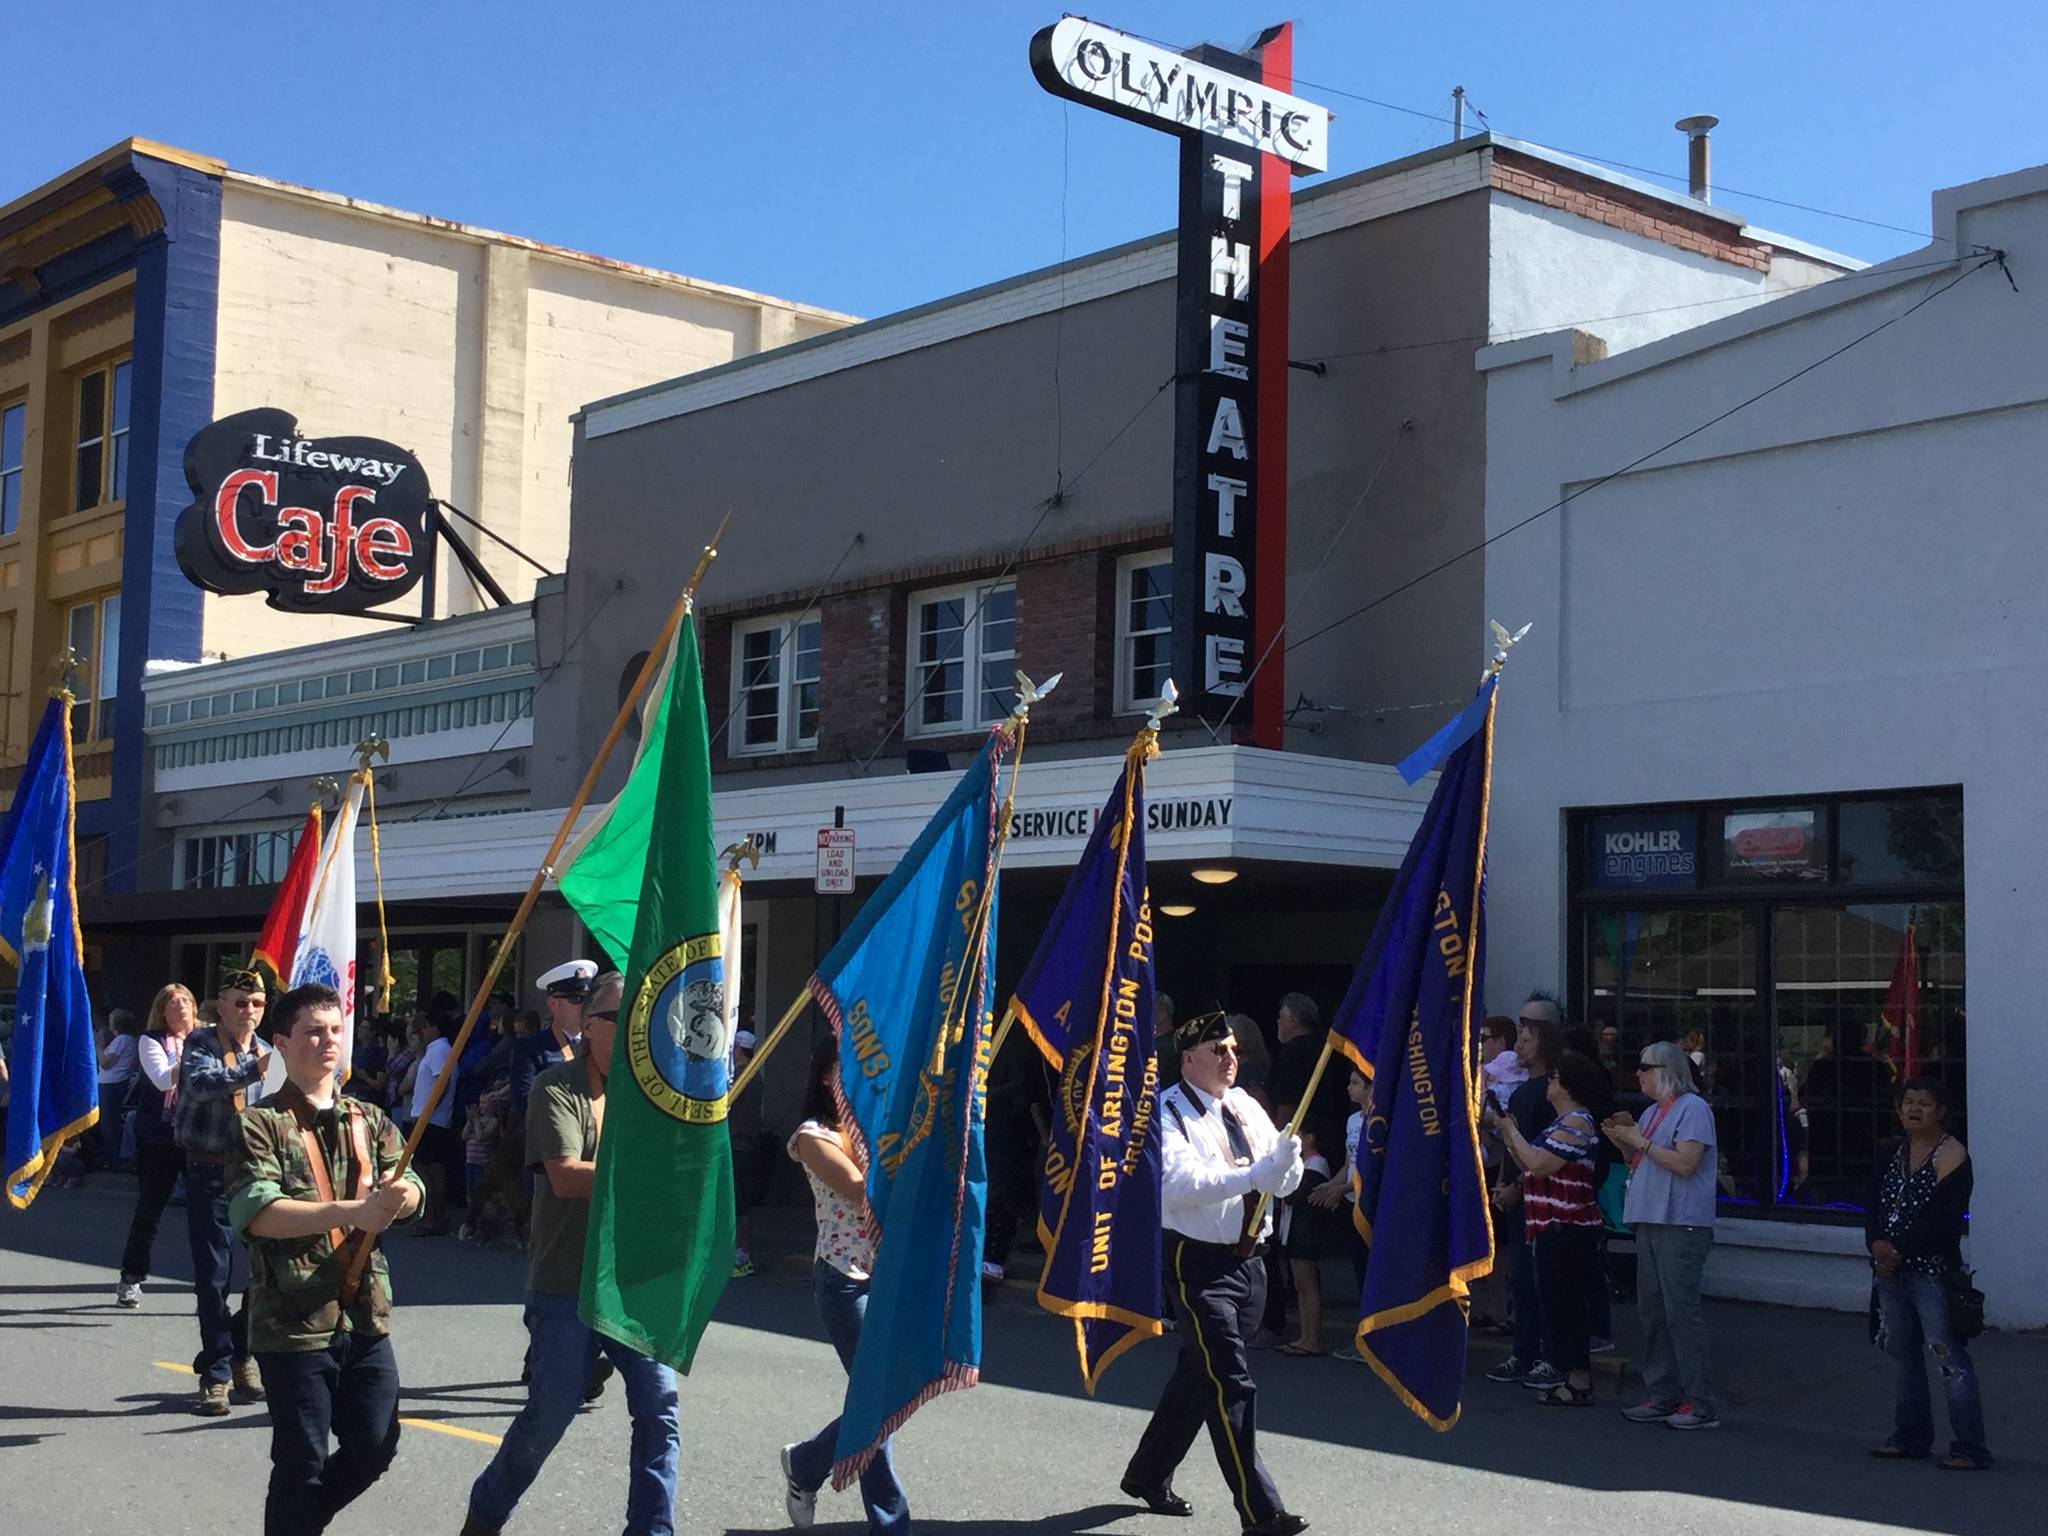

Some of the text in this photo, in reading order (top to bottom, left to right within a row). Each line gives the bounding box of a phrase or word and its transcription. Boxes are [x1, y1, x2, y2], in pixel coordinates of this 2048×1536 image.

[1077, 38, 1313, 152] OLYMPIC
[1204, 153, 1254, 698] THEATRE
[252, 433, 407, 485] Lifeway
[215, 467, 413, 594] Cafe
[1011, 809, 1088, 838] SERVICE
[1147, 799, 1233, 830] SUNDAY
[827, 849, 845, 859] LOAD
[1605, 831, 1681, 853] KOHLER
[821, 868, 849, 878] UNLOAD
[828, 859, 843, 868] AND
[1606, 852, 1695, 881] engines
[825, 878, 844, 888] ONLY
[686, 938, 709, 959] OF
[632, 1024, 647, 1066] THE
[848, 1000, 890, 1078] SONS
[641, 1071, 665, 1098] OF
[1091, 886, 1153, 1273] UNIT OF ARLINGTON POS
[671, 1094, 713, 1119] SEAL
